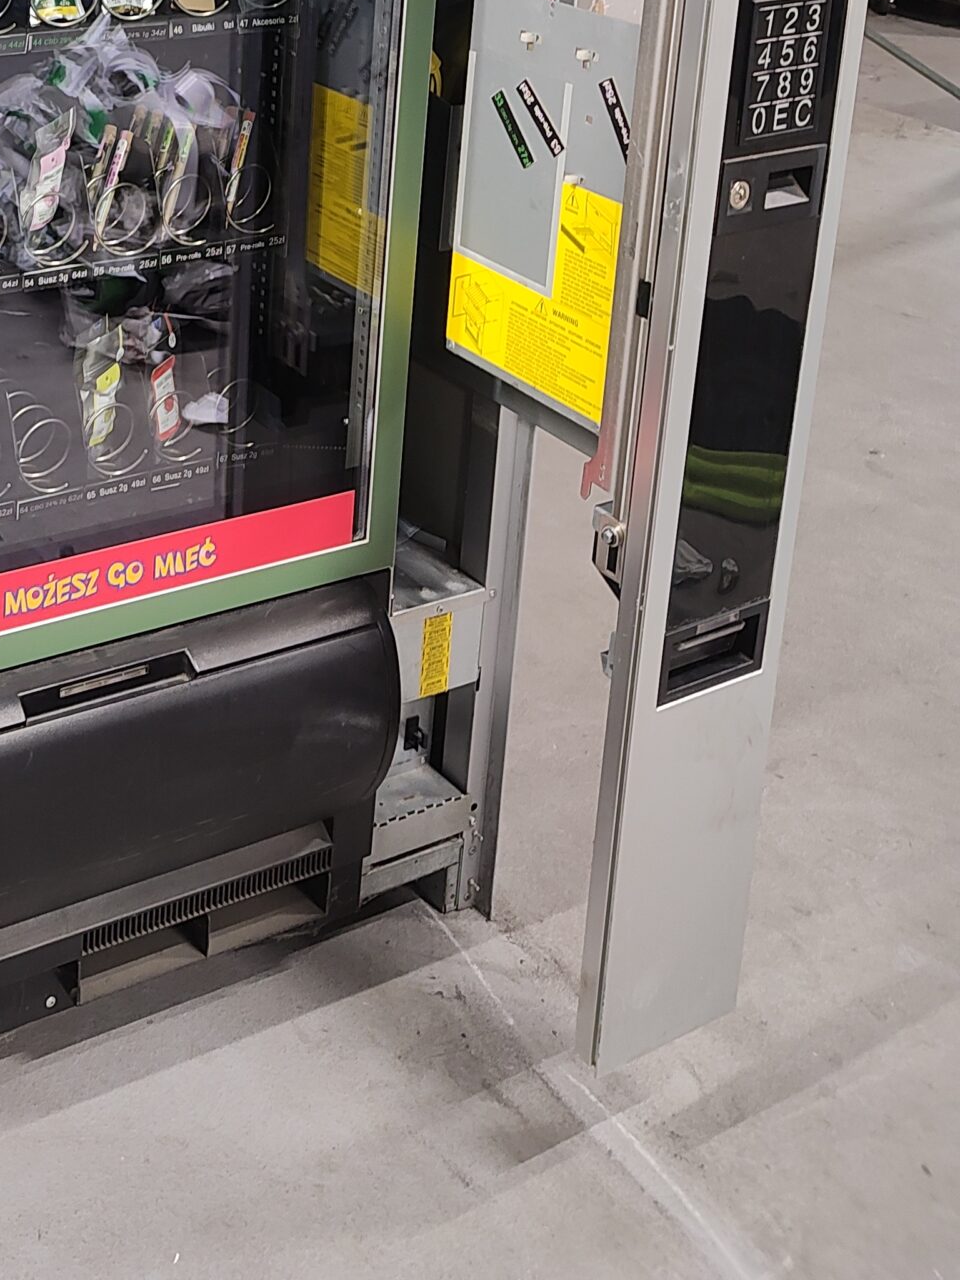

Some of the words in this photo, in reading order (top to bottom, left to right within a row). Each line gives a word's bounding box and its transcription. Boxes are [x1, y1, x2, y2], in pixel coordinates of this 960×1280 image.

[240, 19, 248, 28] 47
[252, 16, 285, 27] Akcesoria
[765, 10, 775, 37] 1
[782, 7, 799, 34] 2
[806, 4, 821, 31] 3
[9, 40, 25, 49] 44zł
[758, 43, 771, 70] 4
[780, 39, 795, 66] 5
[803, 36, 817, 63] 6
[756, 75, 770, 102] 7
[777, 71, 791, 98] 8
[799, 68, 814, 95] 9
[752, 107, 766, 135] 0
[773, 103, 790, 131] E
[795, 99, 813, 127] C
[205, 247, 223, 257] 25zł
[58, 272, 68, 283] 3g
[552, 308, 579, 328] WARNING
[118, 482, 128, 493] 2g
[3, 568, 100, 619] MOŻESZ
[107, 561, 144, 589] GO
[153, 537, 218, 580] MIEĆ
